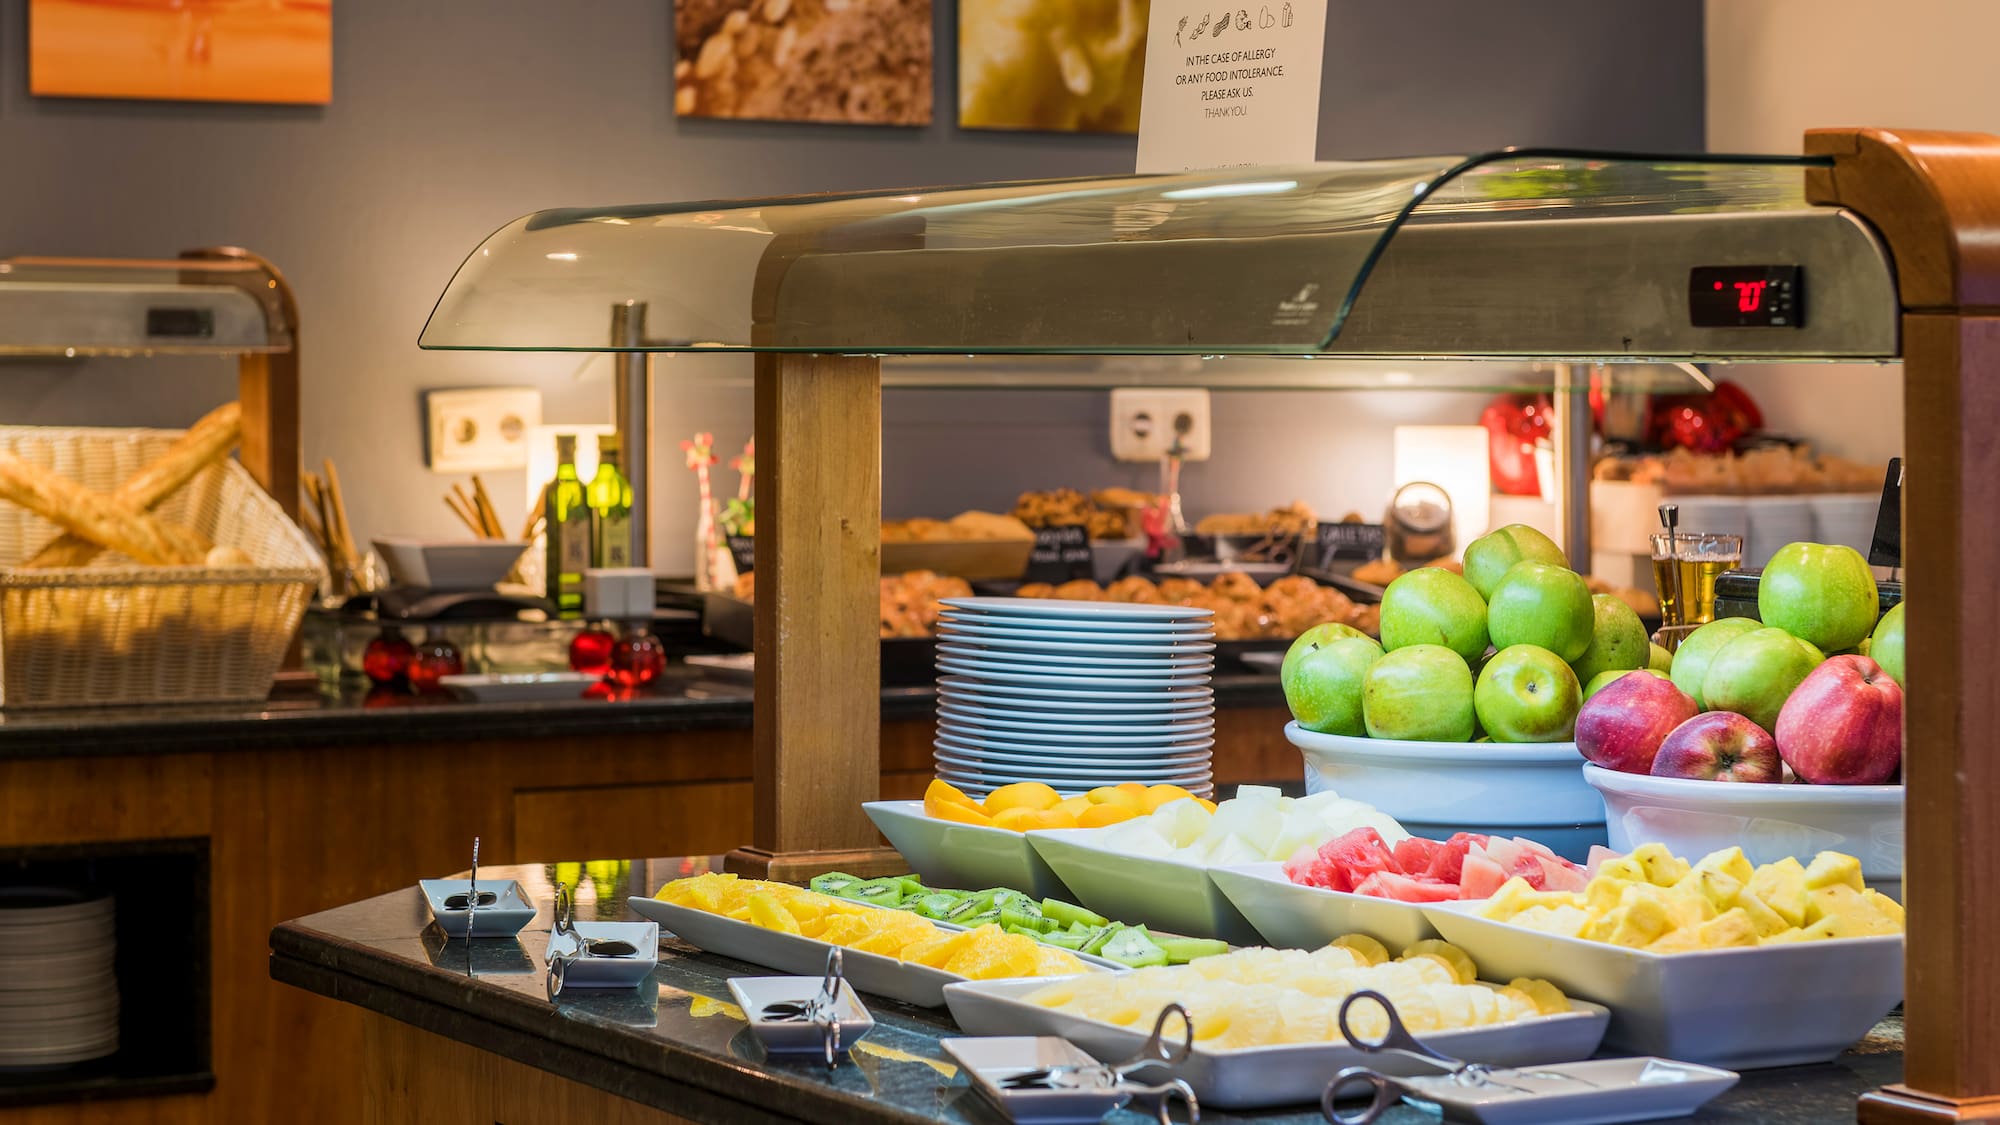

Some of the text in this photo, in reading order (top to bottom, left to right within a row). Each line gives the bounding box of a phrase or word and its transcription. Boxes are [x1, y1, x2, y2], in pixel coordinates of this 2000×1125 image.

[1186, 48, 1276, 67] IN THE CASE OF ALLERGY
[1175, 75, 1187, 85] OR
[1188, 73, 1204, 84] ANY
[1205, 71, 1228, 82] FOOD
[1201, 89, 1226, 101] PLEASE
[1227, 87, 1241, 98] ASK
[1205, 107, 1230, 119] THANK
